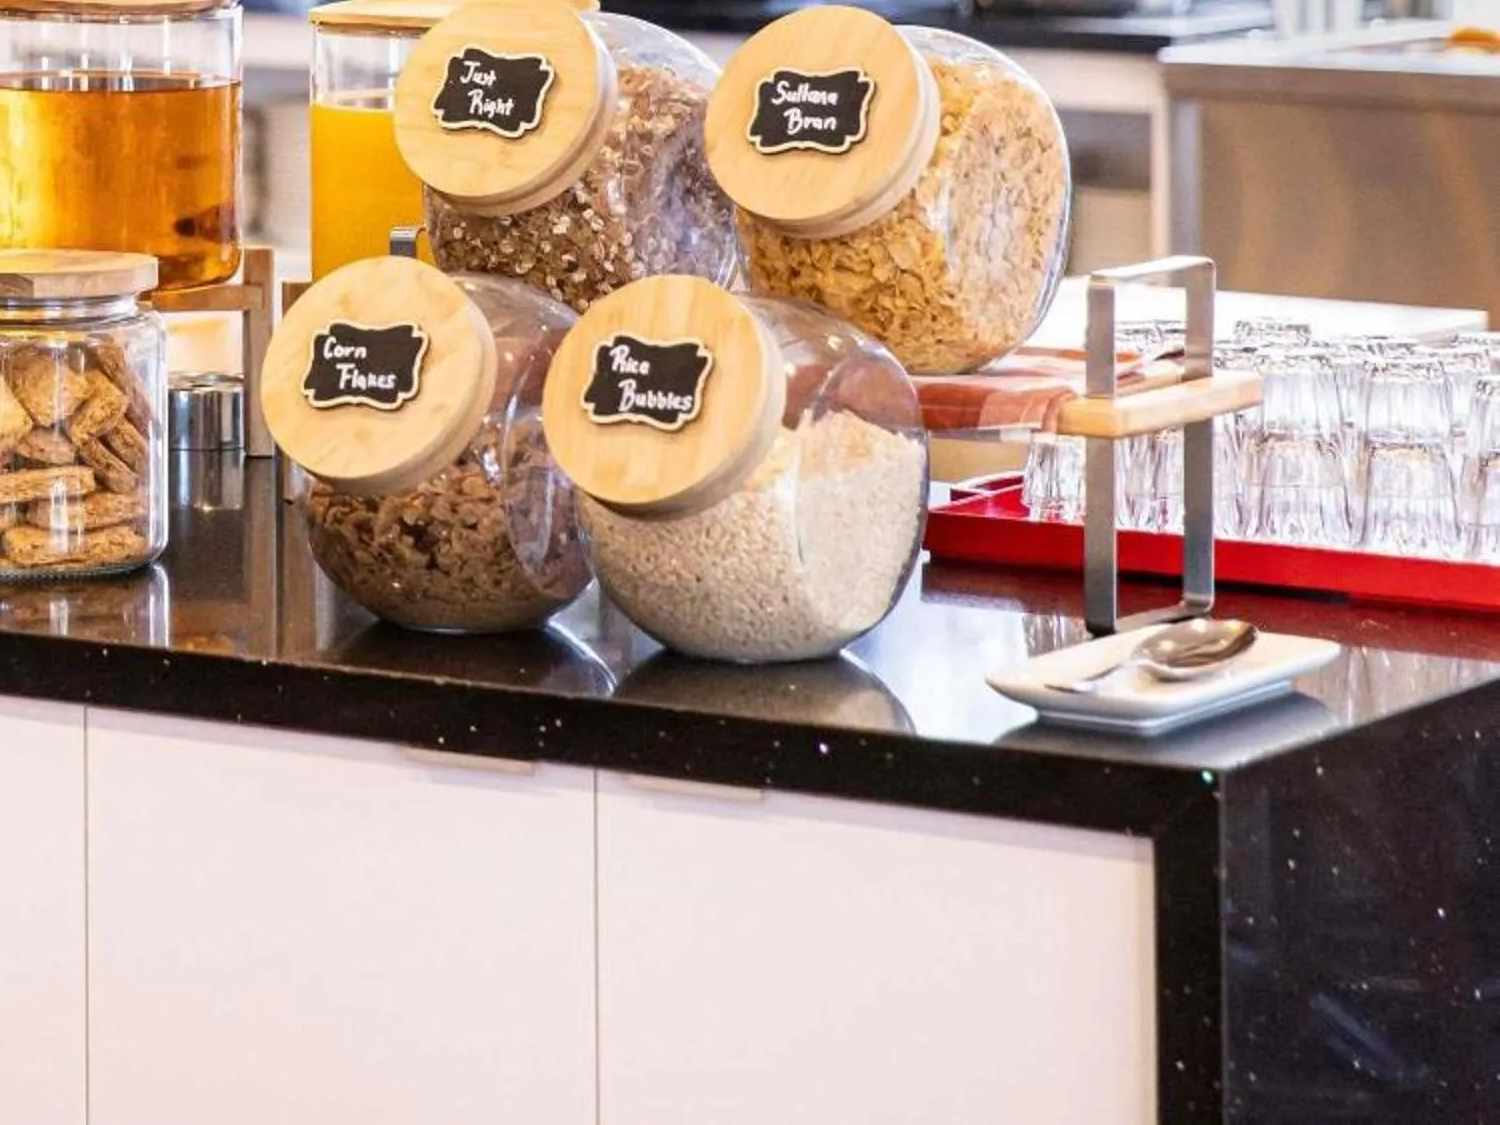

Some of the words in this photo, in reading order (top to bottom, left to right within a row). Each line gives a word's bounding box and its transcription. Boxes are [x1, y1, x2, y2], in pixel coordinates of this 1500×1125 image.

[460, 60, 497, 87] Just
[467, 88, 515, 119] Right
[771, 80, 839, 106] Sultana
[782, 106, 838, 135] Bran
[322, 335, 368, 360] Corn
[609, 344, 651, 375] Rice
[335, 362, 397, 390] Flakes
[617, 378, 693, 412] Bubbles
